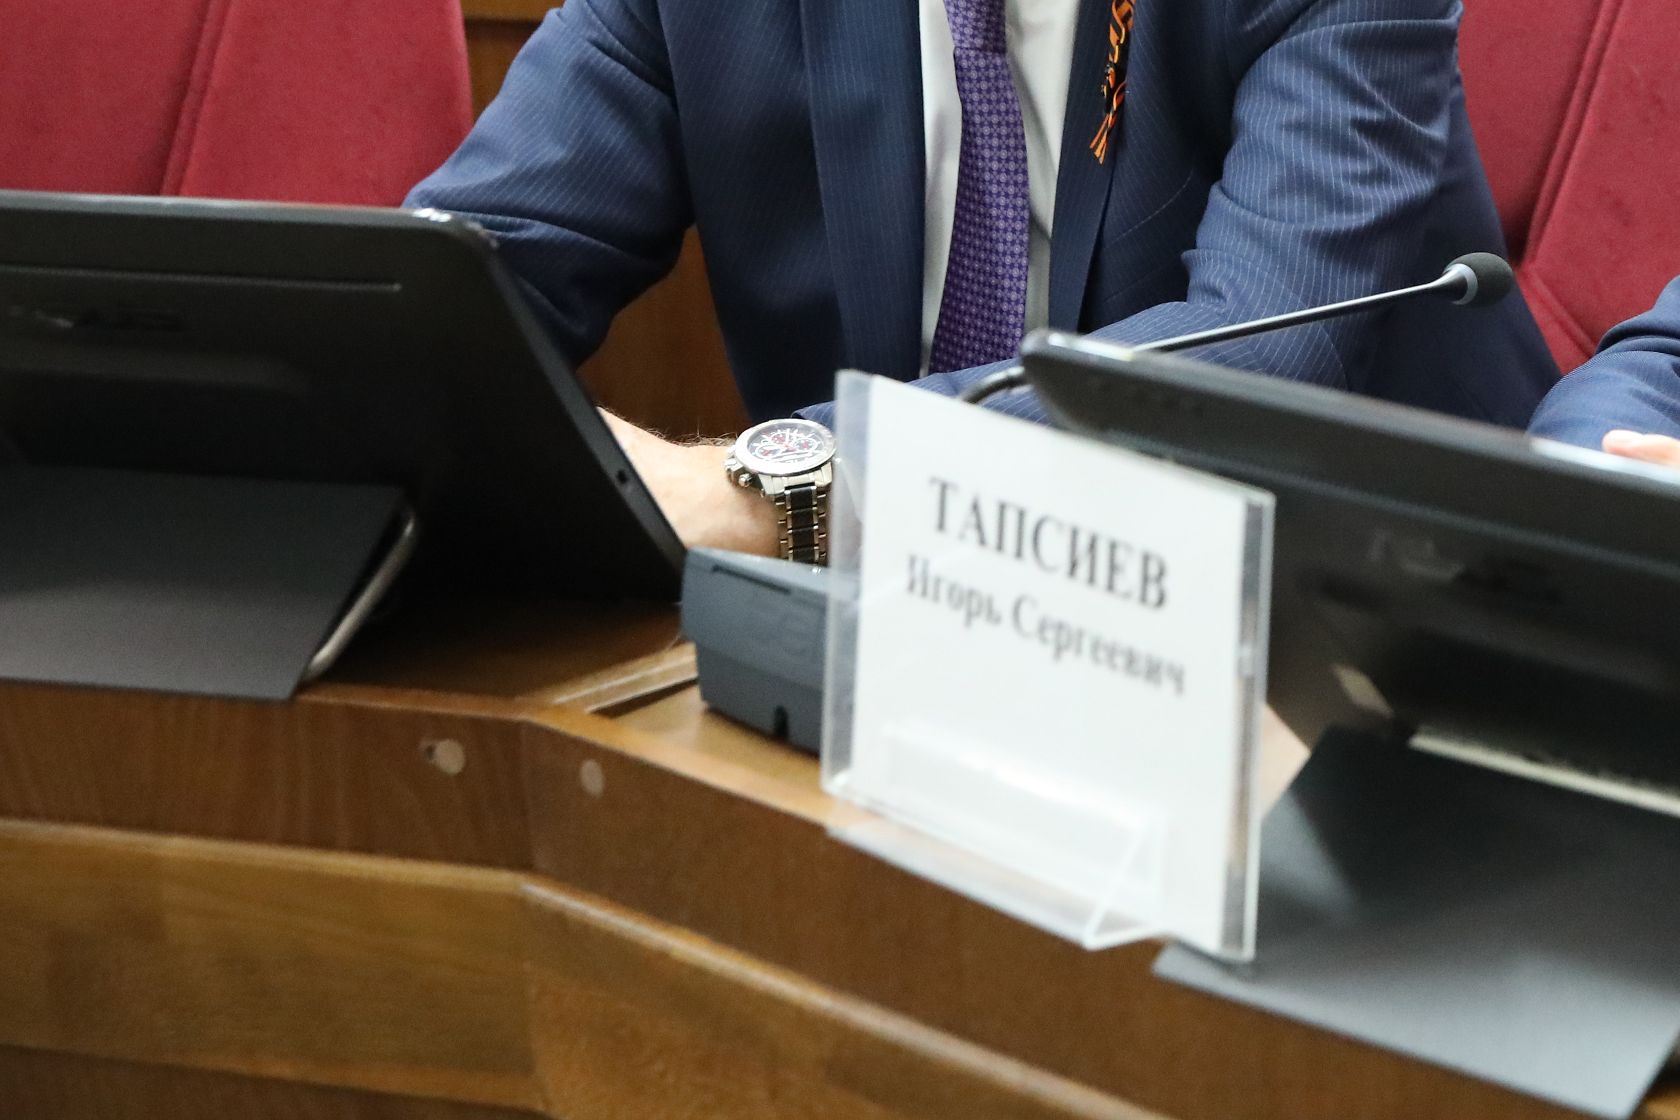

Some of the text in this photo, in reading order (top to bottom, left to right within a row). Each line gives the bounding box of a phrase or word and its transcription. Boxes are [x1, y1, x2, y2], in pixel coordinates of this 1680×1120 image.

[928, 476, 1168, 610] ТАПСИЕВ
[908, 554, 1185, 697] Игорь Сергеевич
